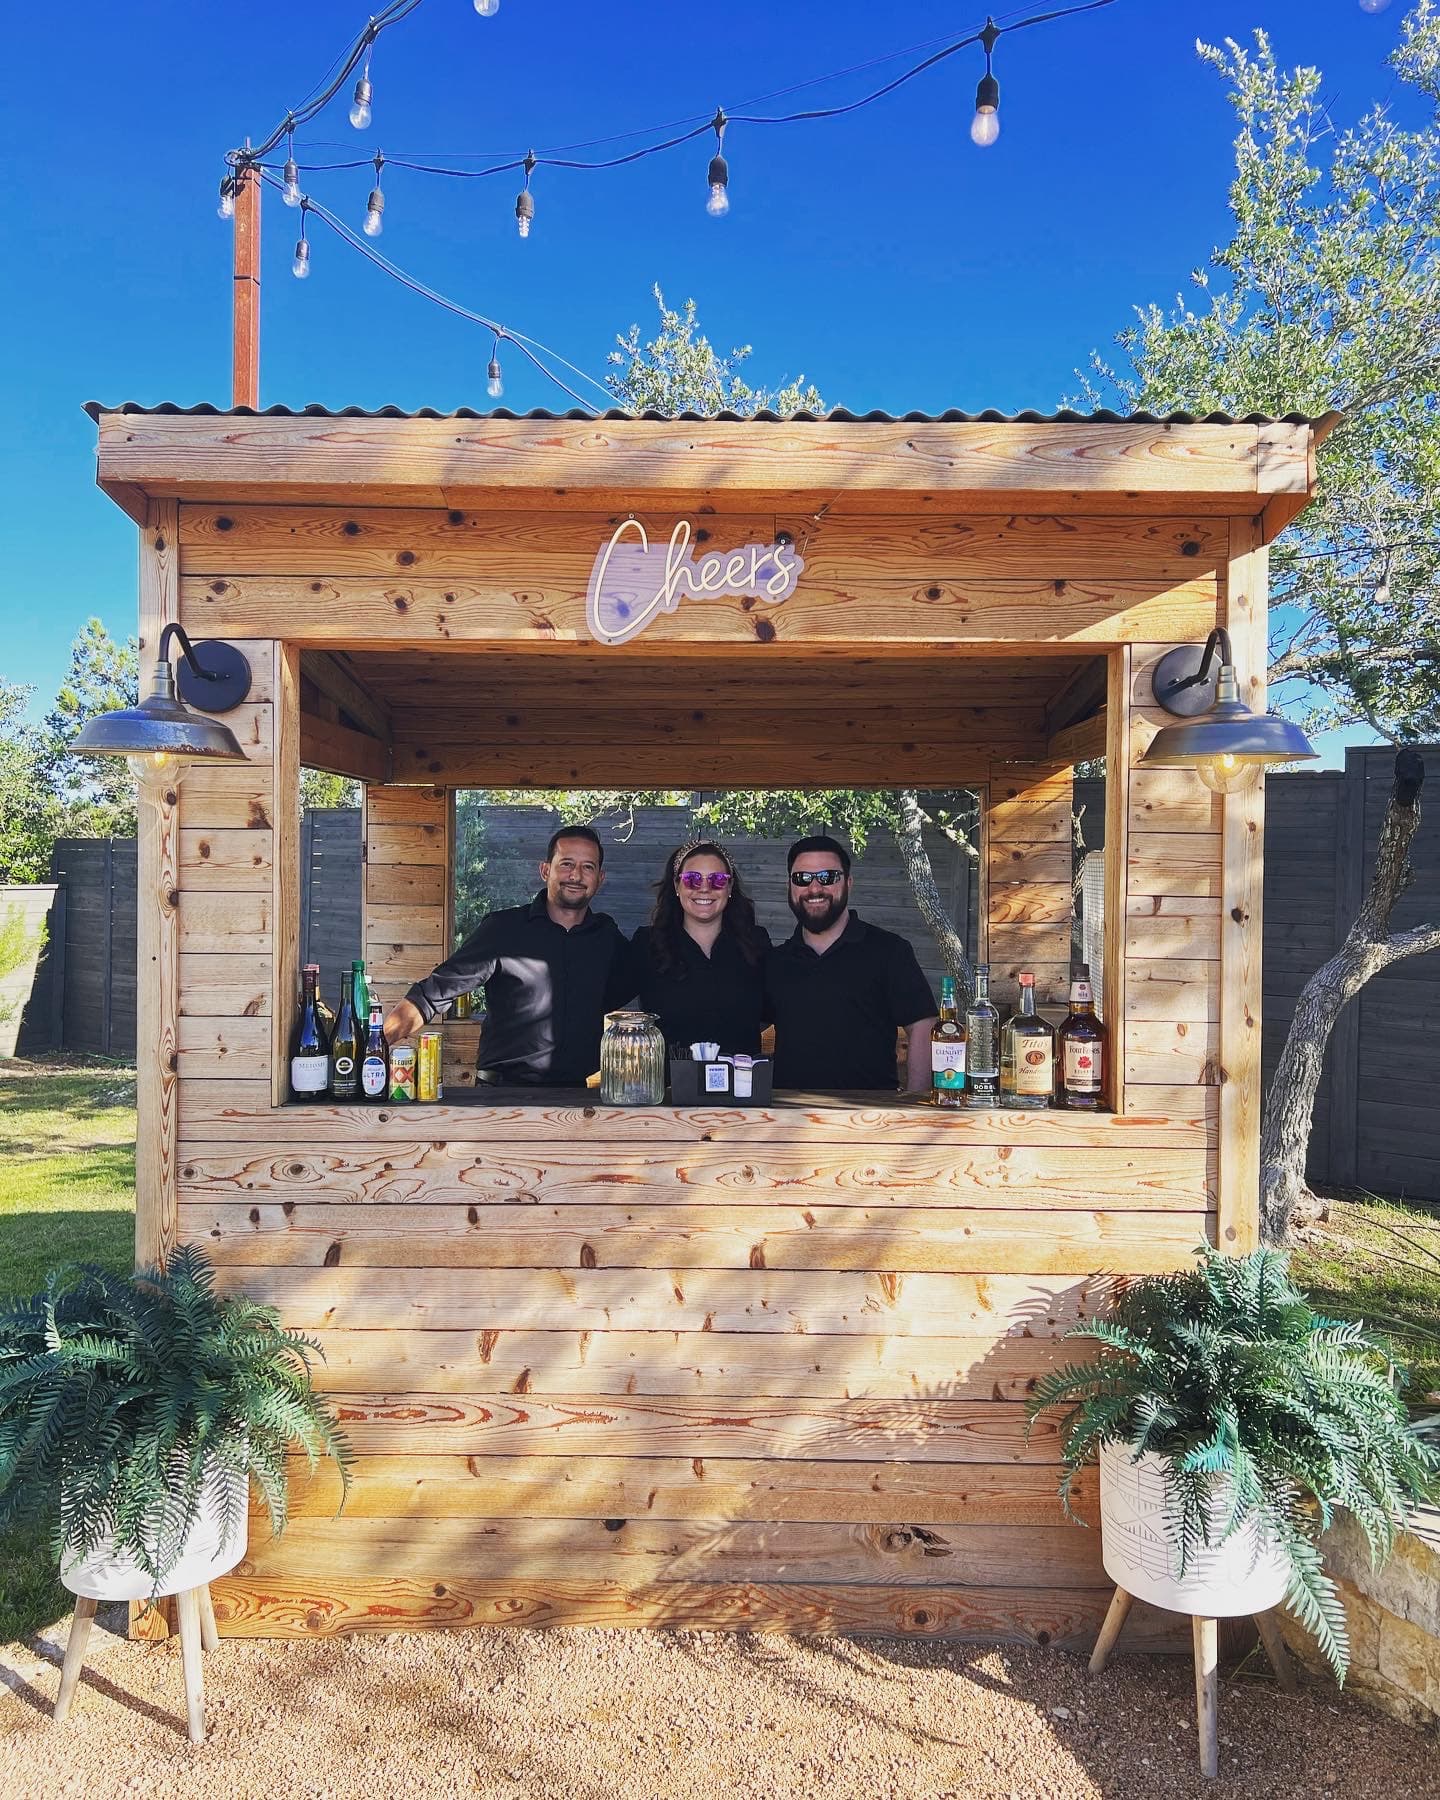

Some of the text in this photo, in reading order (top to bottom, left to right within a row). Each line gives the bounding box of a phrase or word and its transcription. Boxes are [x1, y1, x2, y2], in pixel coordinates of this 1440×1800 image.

[593, 519, 796, 638] Cheers
[1021, 1039, 1049, 1048] Tito's
[1082, 1046, 1100, 1054] Rses
